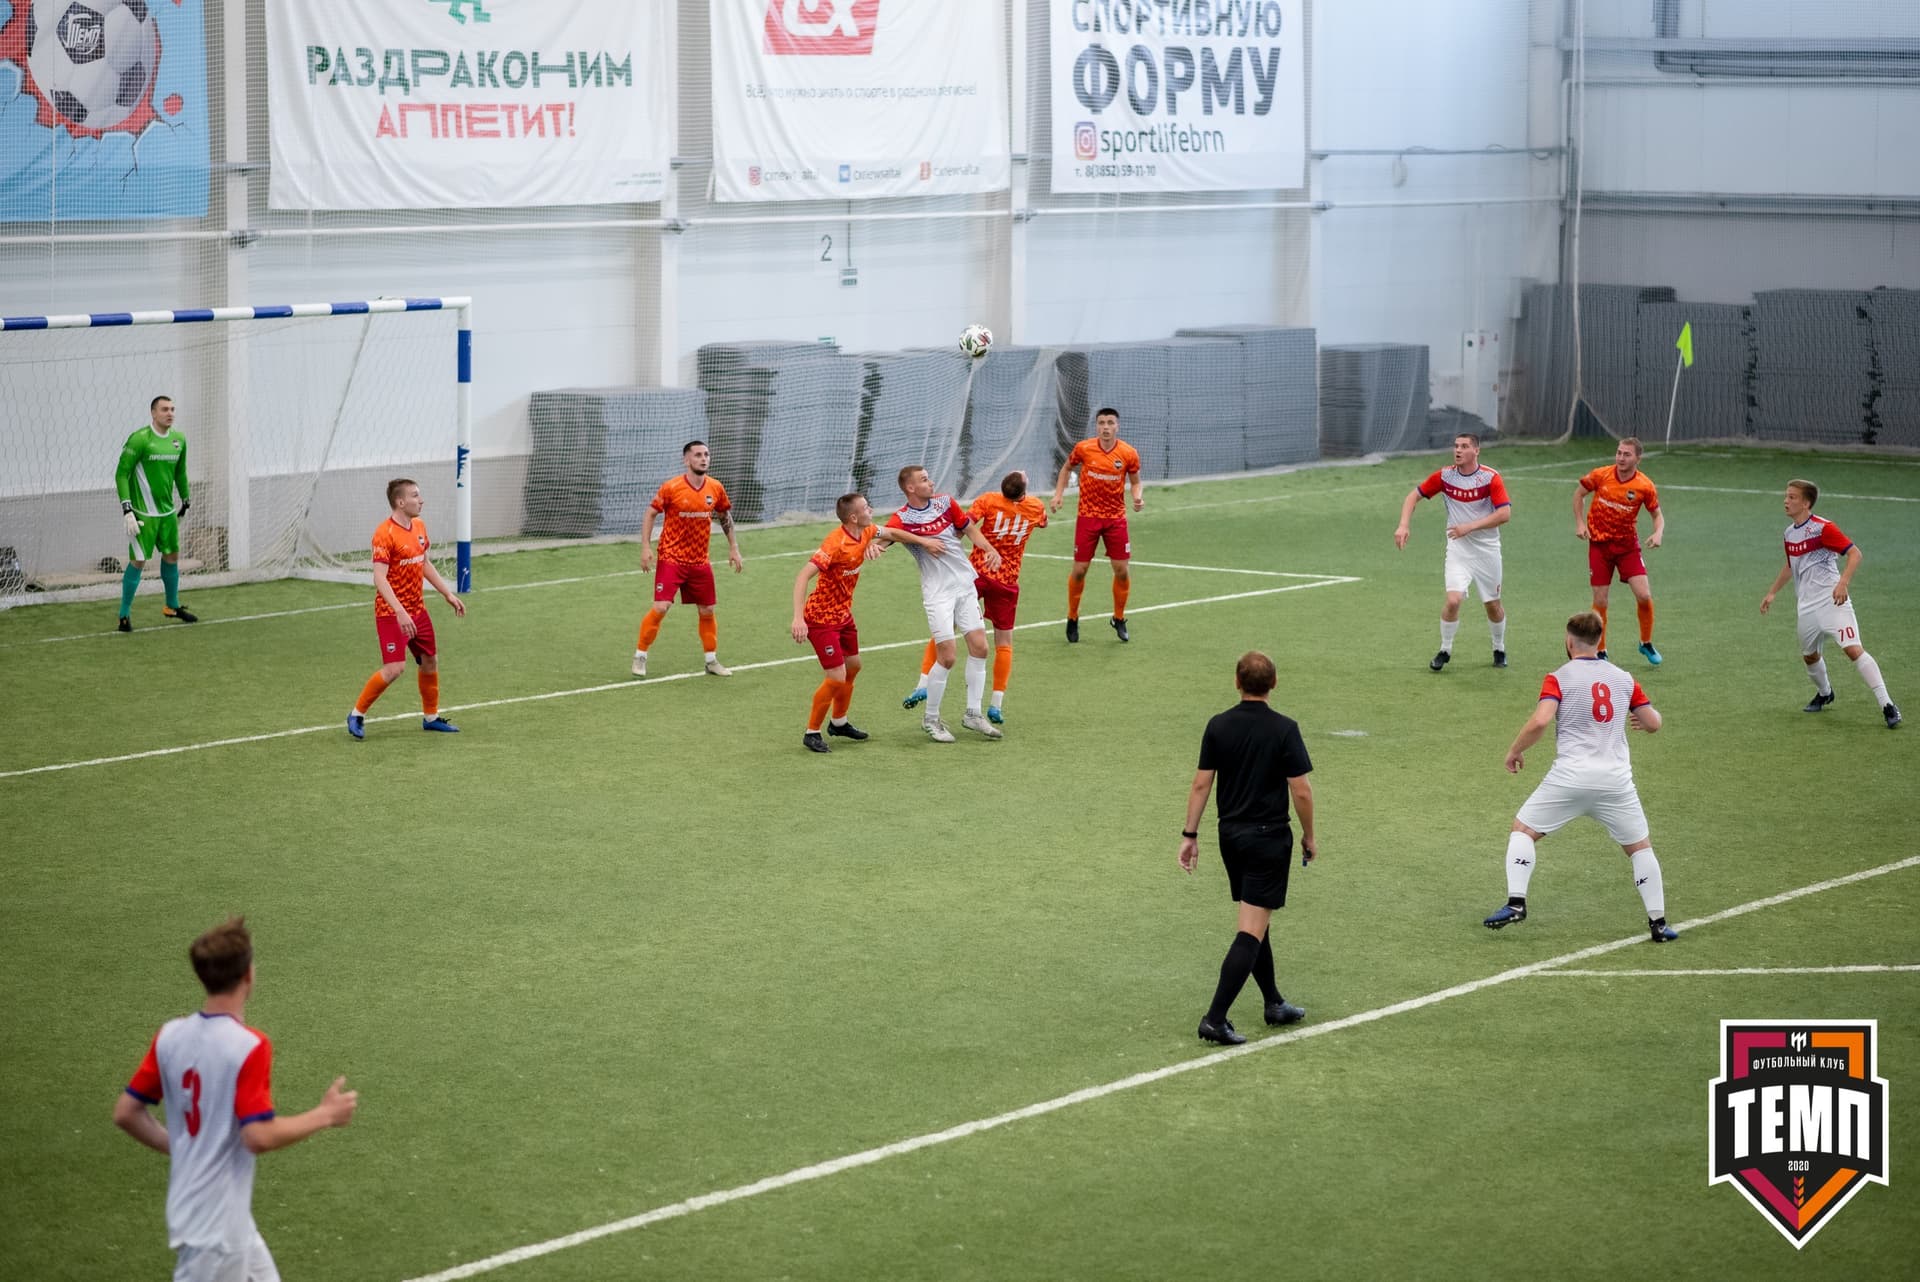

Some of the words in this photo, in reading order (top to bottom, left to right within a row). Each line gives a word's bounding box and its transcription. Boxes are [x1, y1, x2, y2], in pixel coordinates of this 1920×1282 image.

[306, 46, 632, 96] РАЗДРАКОНИМ
[1072, 43, 1281, 116] ФОРМУ
[375, 101, 576, 139] АППЕТИТ!
[1100, 122, 1225, 160] sportlifebrn
[820, 234, 832, 262] 2
[991, 511, 1029, 545] 44
[1837, 626, 1855, 642] 70
[1591, 681, 1615, 723] 8
[181, 1067, 202, 1138] 3
